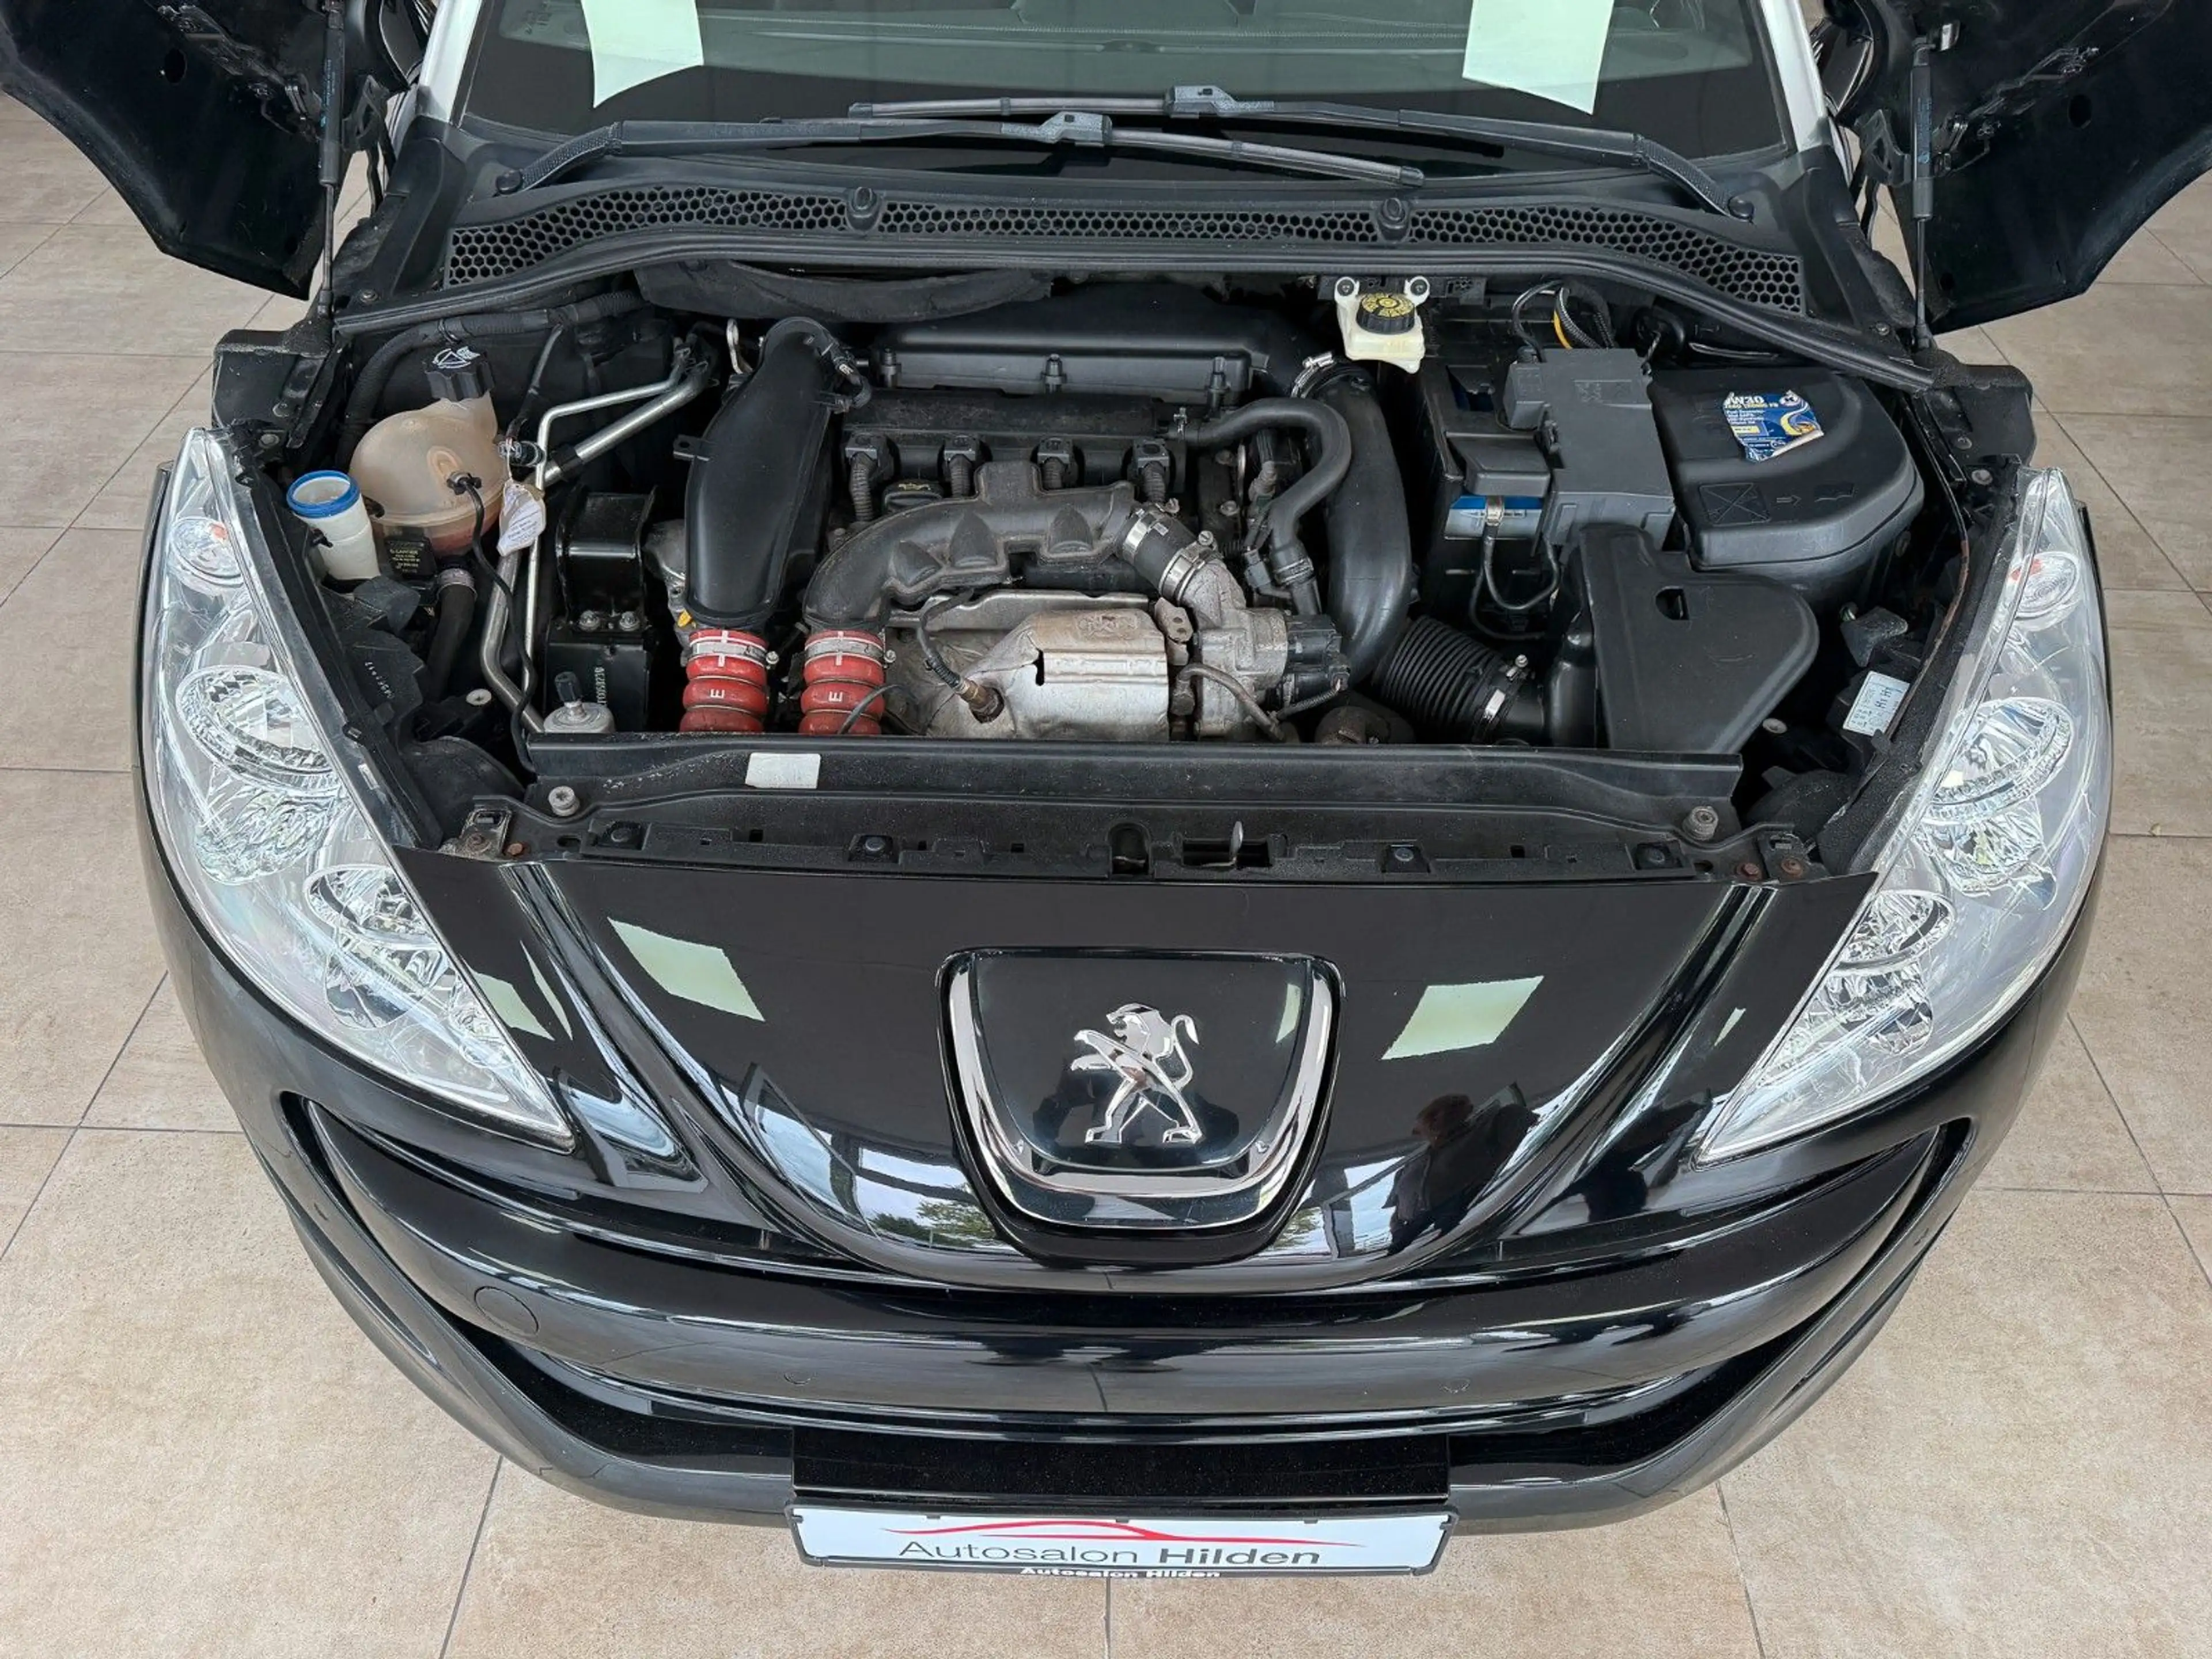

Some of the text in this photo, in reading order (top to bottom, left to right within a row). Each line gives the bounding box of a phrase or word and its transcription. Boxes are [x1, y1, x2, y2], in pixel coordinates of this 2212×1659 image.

[899, 1541, 1320, 1564] Autosalon Hilden
[1020, 1566, 1221, 1578] Autosalon Hilden
